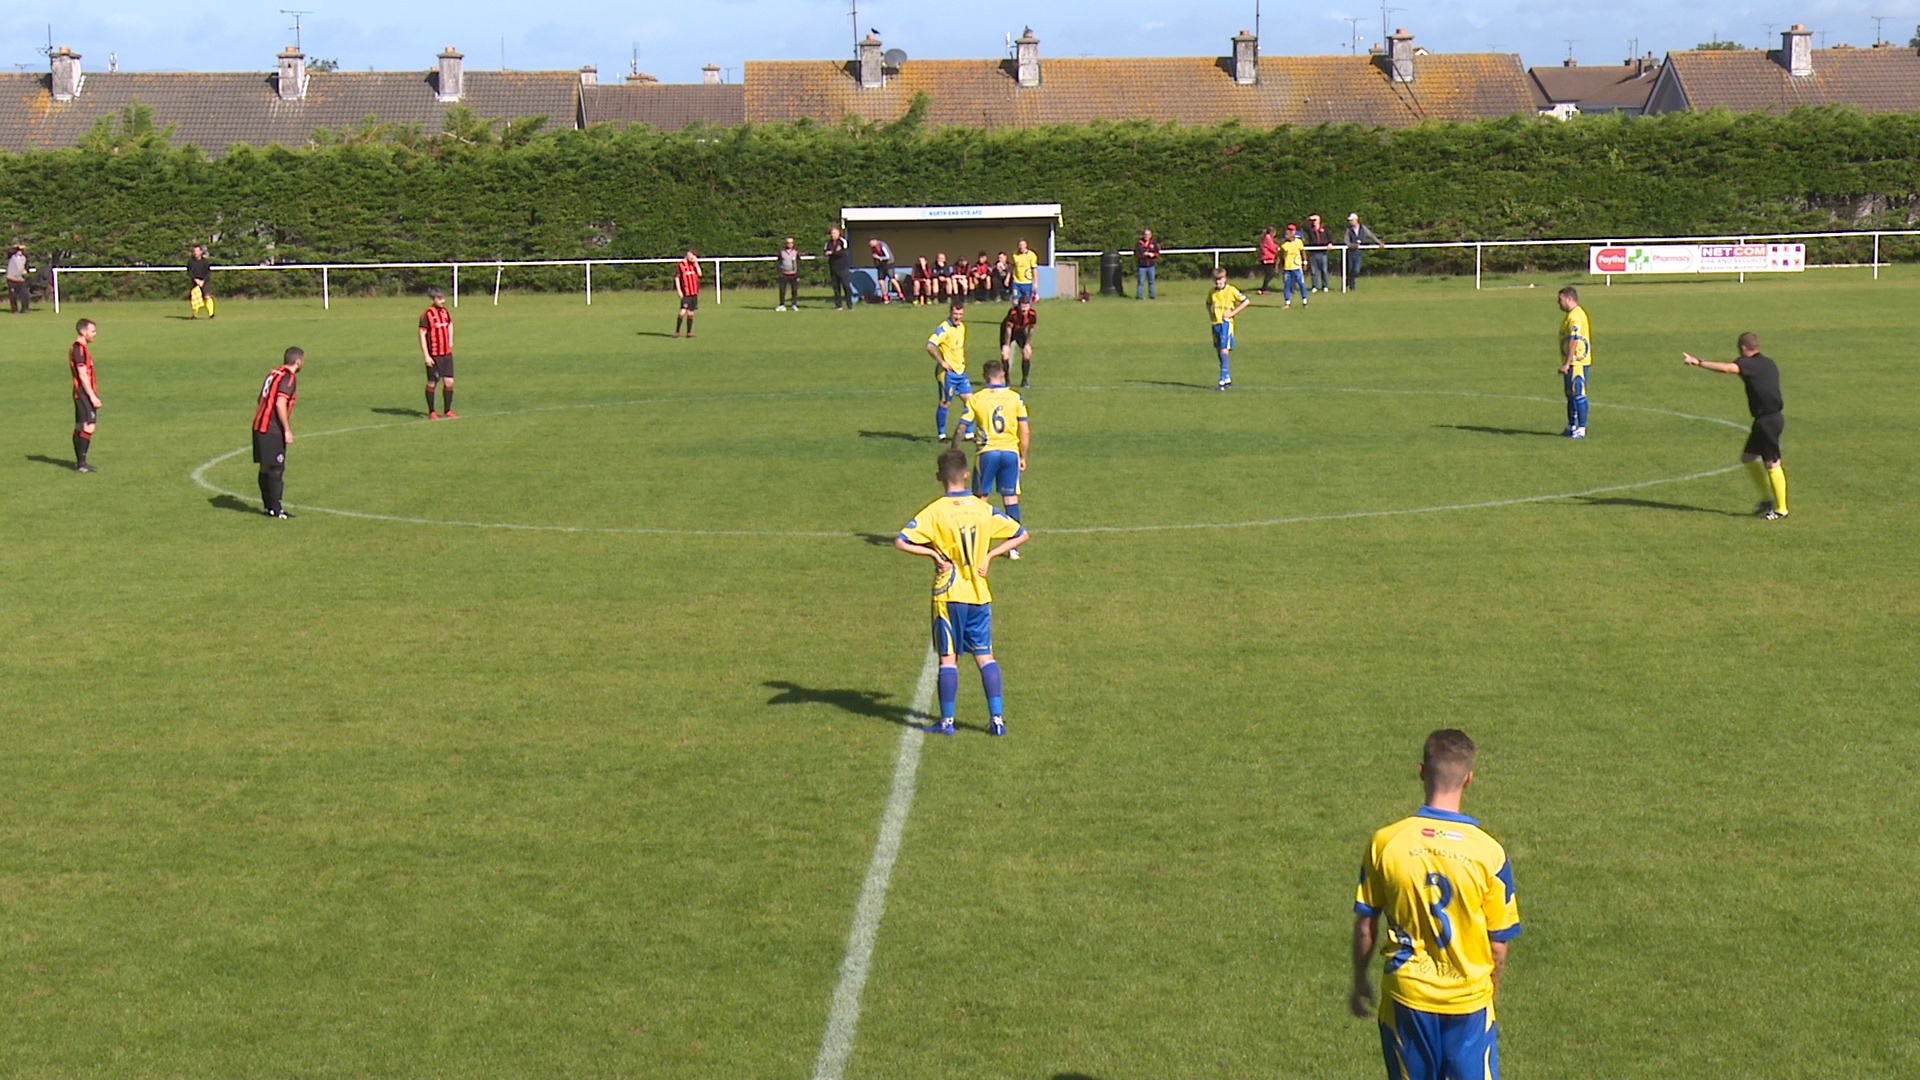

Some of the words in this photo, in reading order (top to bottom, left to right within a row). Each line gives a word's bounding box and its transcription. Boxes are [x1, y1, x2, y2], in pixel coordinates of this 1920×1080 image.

[1598, 255, 1625, 265] Faythe
[1652, 255, 1690, 263] Pharmacy
[262, 375, 274, 398] 8
[992, 405, 1005, 434] 6
[959, 524, 976, 566] 11
[1425, 872, 1453, 948] 3
